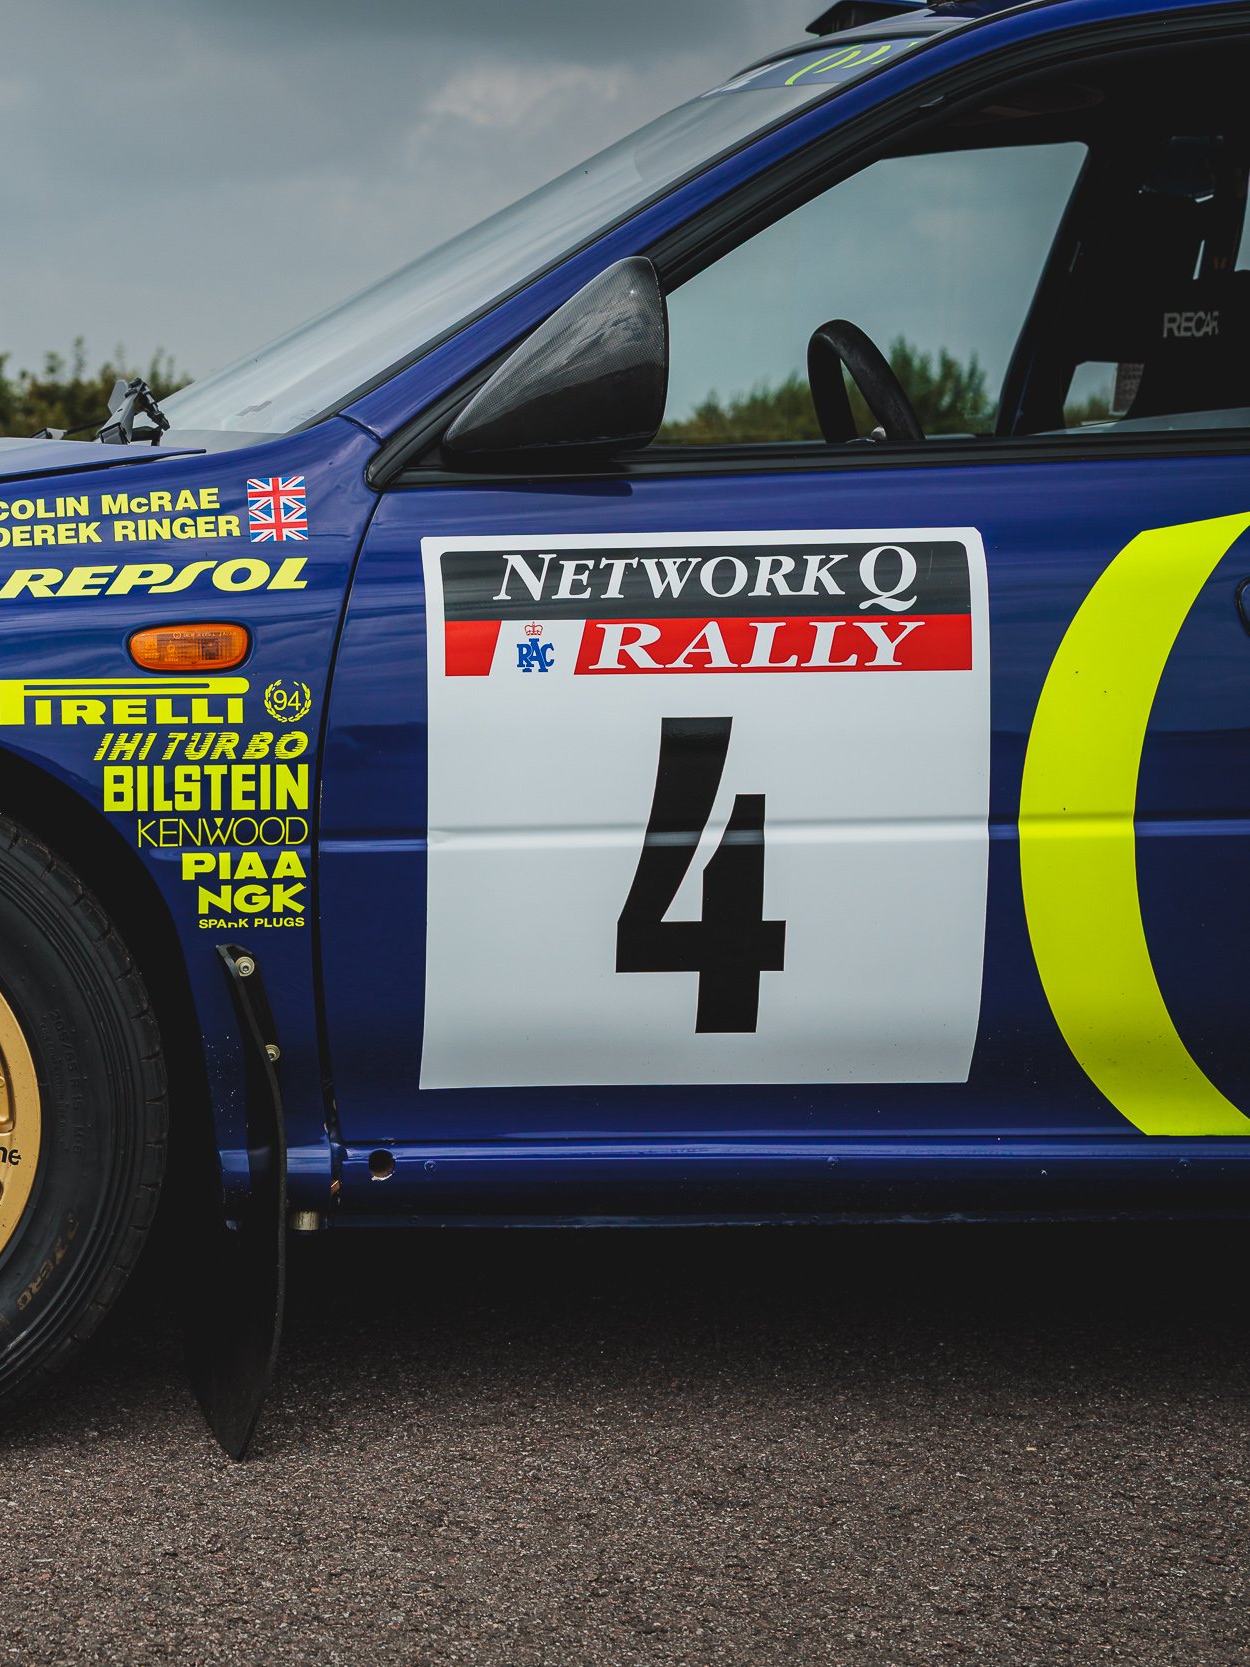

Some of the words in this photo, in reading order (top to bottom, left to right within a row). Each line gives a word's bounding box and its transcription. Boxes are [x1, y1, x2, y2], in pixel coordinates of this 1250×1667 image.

[101, 487, 221, 516] McRAE
[113, 515, 241, 542] RINGER
[492, 553, 849, 601] NETWORK
[858, 545, 918, 612] Q
[516, 637, 555, 673] RAC
[588, 620, 926, 669] RALLY
[272, 689, 302, 711] 94
[93, 732, 158, 761] IHI
[161, 730, 309, 761] TURBO
[103, 763, 309, 812] BILSTEIN
[137, 816, 309, 848] KENWOOD
[181, 850, 307, 881] PIAA
[615, 716, 787, 1034] 4
[197, 882, 307, 915] NGK
[254, 916, 306, 928] PLUGS
